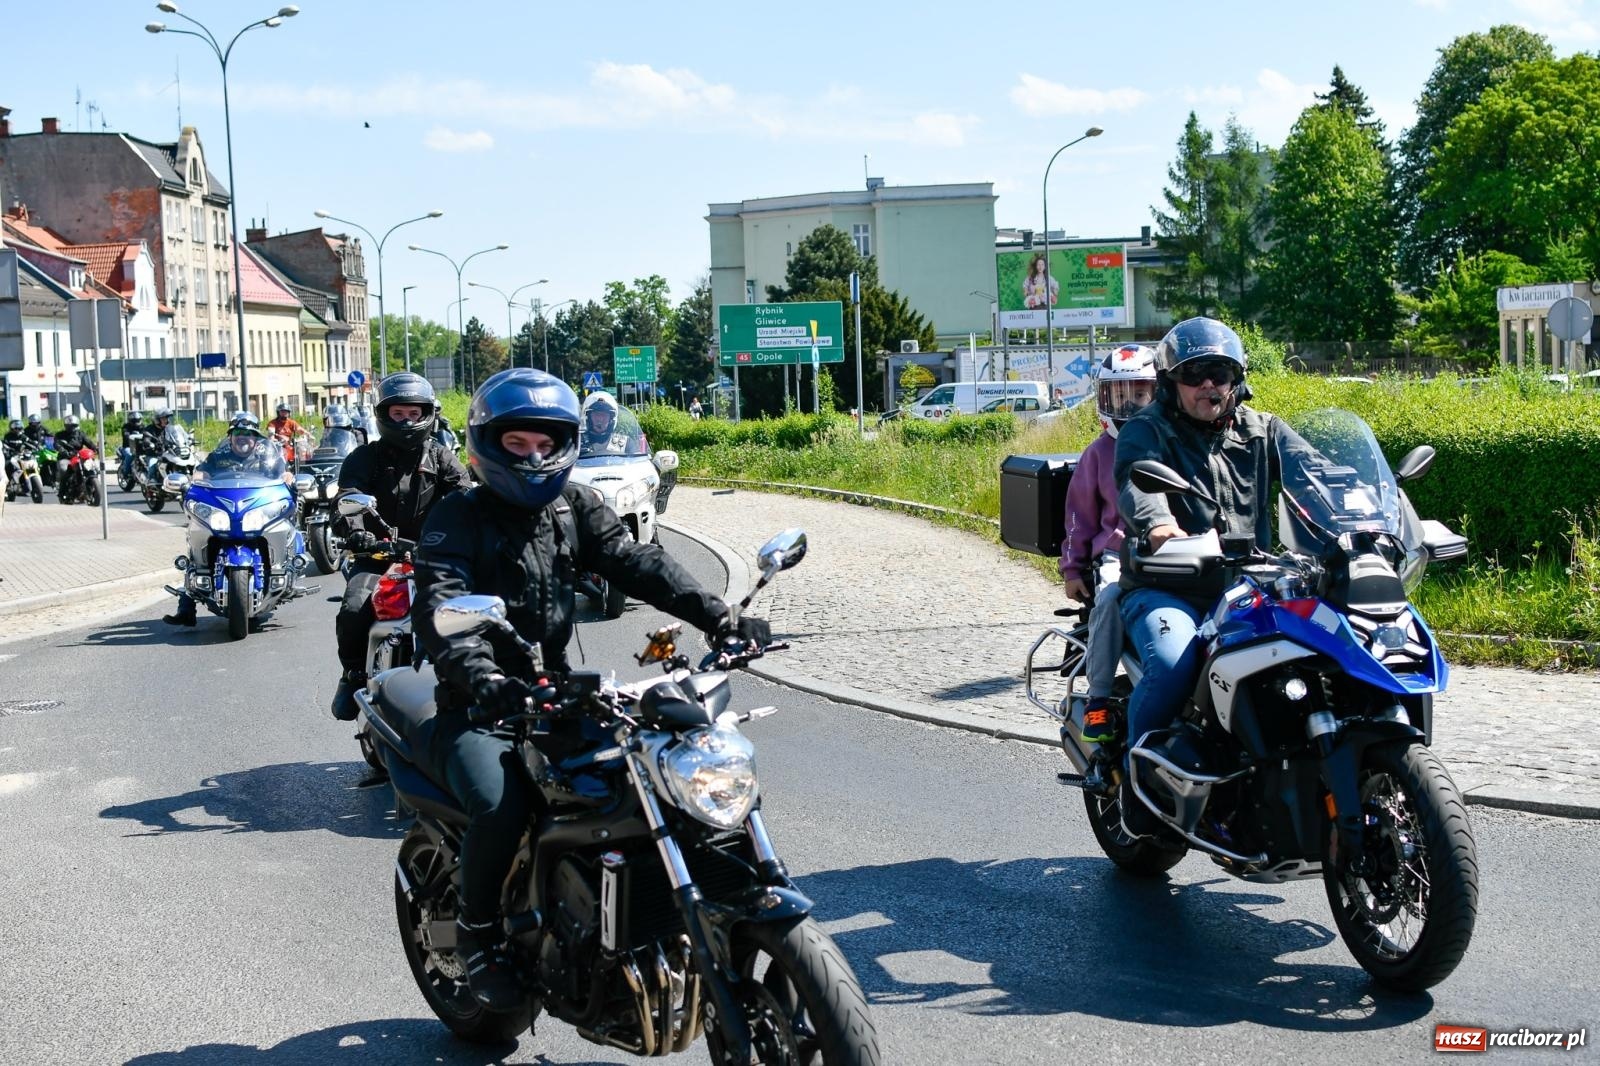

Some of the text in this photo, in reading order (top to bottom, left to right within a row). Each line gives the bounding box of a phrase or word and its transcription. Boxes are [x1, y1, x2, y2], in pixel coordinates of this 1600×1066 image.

[1071, 273, 1085, 281] EKO
[1067, 280, 1108, 289] reaktywacja
[755, 307, 784, 315] Rybnik
[755, 317, 787, 325] Gliwice
[781, 328, 805, 336] Miejski
[758, 337, 830, 346] Starostwo Powiowe
[756, 353, 783, 362] Opole
